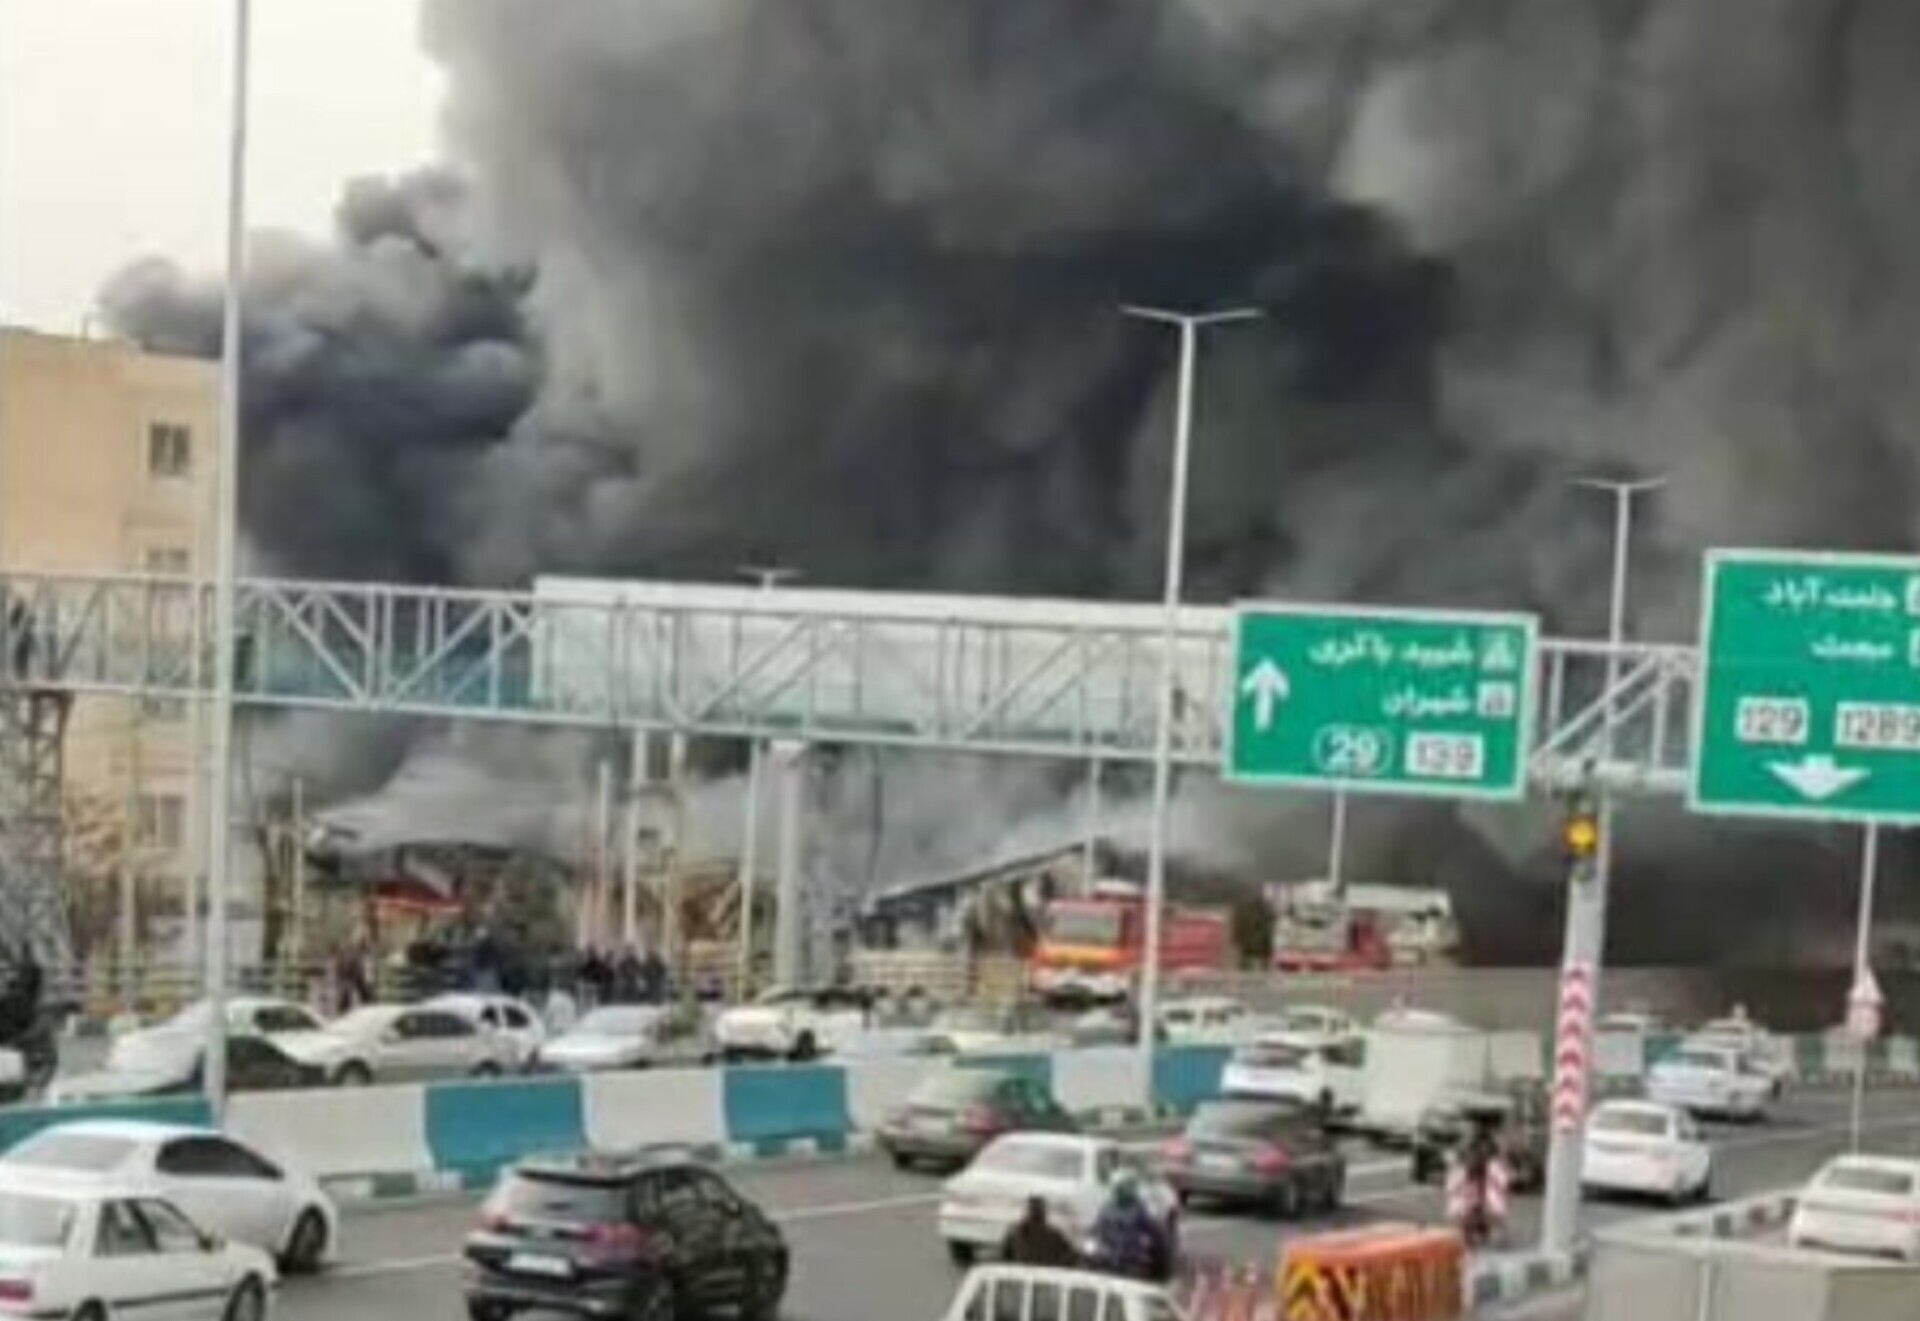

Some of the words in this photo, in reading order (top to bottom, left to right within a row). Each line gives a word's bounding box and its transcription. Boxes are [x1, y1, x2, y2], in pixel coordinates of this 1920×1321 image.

[1307, 630, 1394, 668] باکری
[1402, 636, 1473, 669] شهید
[1743, 704, 1804, 740] 129
[1327, 730, 1381, 774] 29
